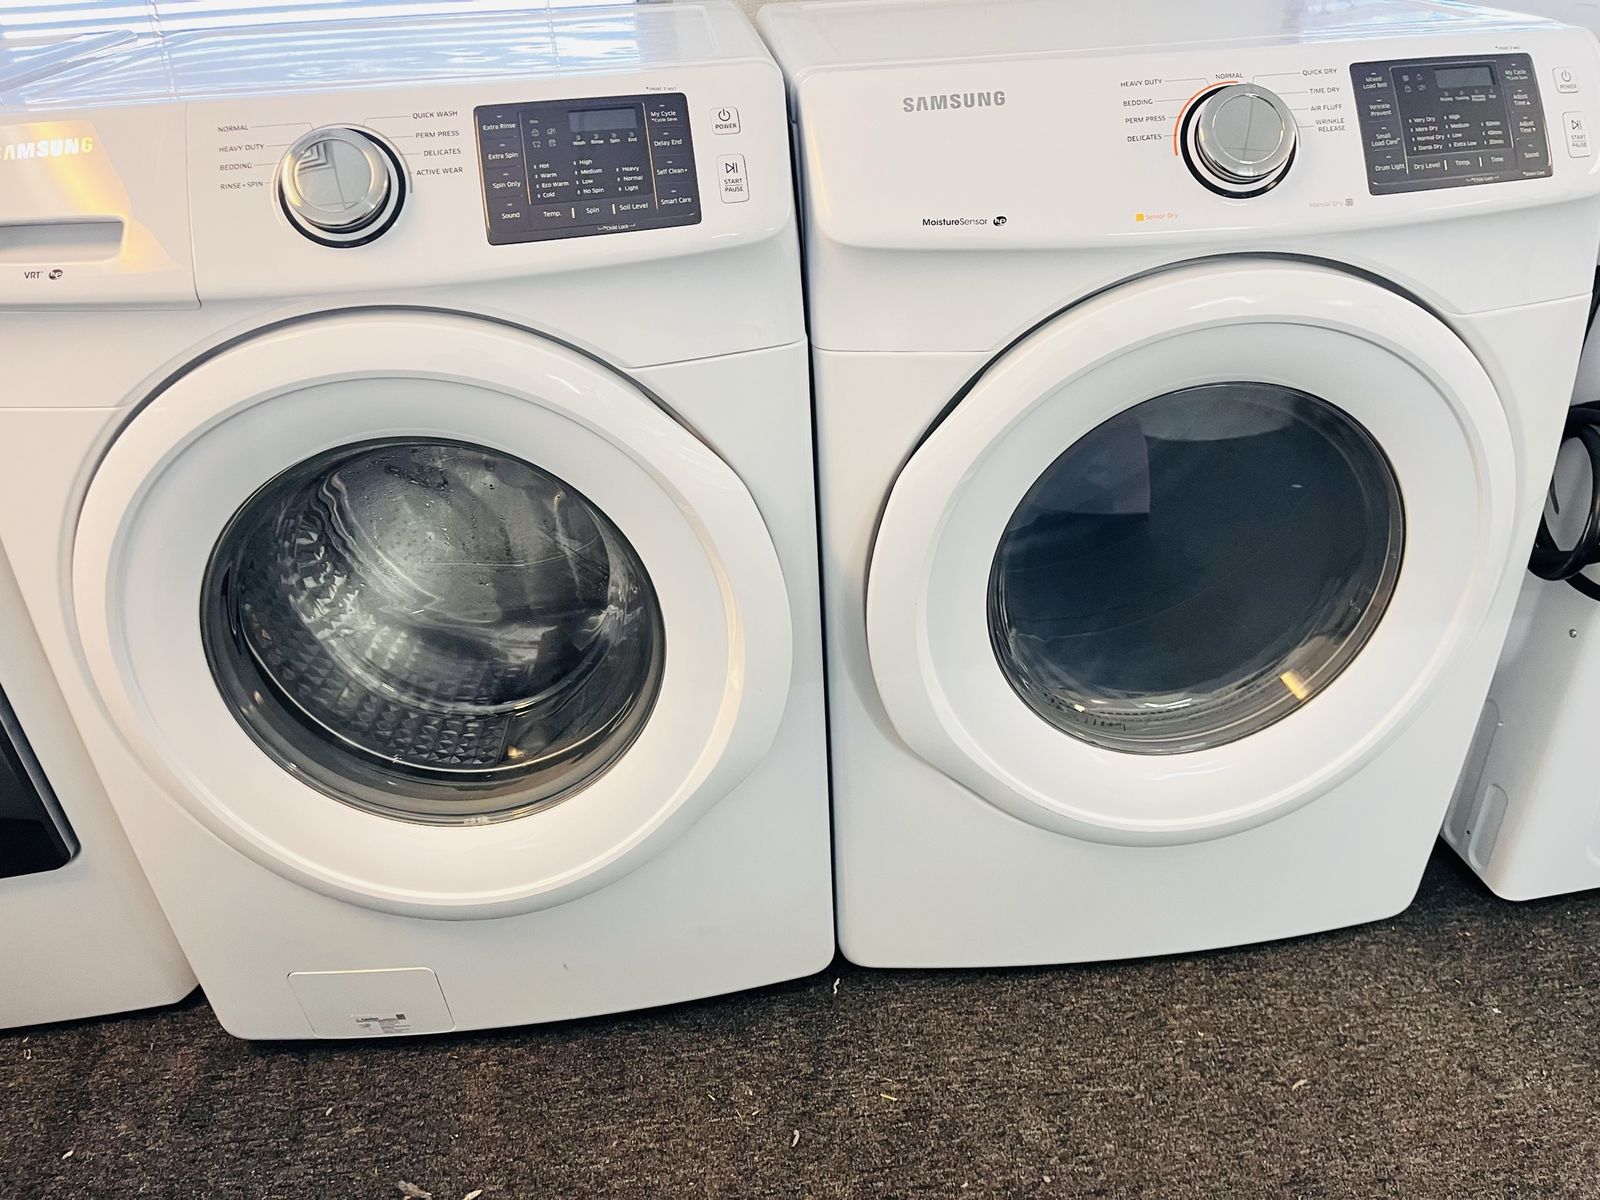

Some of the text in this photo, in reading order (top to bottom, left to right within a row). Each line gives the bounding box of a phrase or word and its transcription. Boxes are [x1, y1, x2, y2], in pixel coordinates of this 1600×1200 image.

[1215, 72, 1244, 80] NORMAL
[1120, 80, 1142, 88] HEAVY
[902, 90, 1006, 113] SAMSUNG
[1122, 99, 1153, 107] BEDDING
[1125, 116, 1144, 124] PERM
[1315, 117, 1344, 125] WRINKLE
[217, 124, 248, 132] NORMAL
[1127, 134, 1162, 142] DELICATES
[0, 137, 94, 160] AMSUNG
[244, 143, 265, 151] DUTY
[423, 147, 461, 156] DELICATES
[505, 151, 519, 159] Spin
[219, 163, 252, 171] BEDDING
[1391, 163, 1405, 171] Light
[1425, 161, 1441, 169] Level
[416, 166, 463, 176] ACTIVE WEAR
[619, 203, 632, 211] Soil
[922, 217, 988, 227] MoistureSensor
